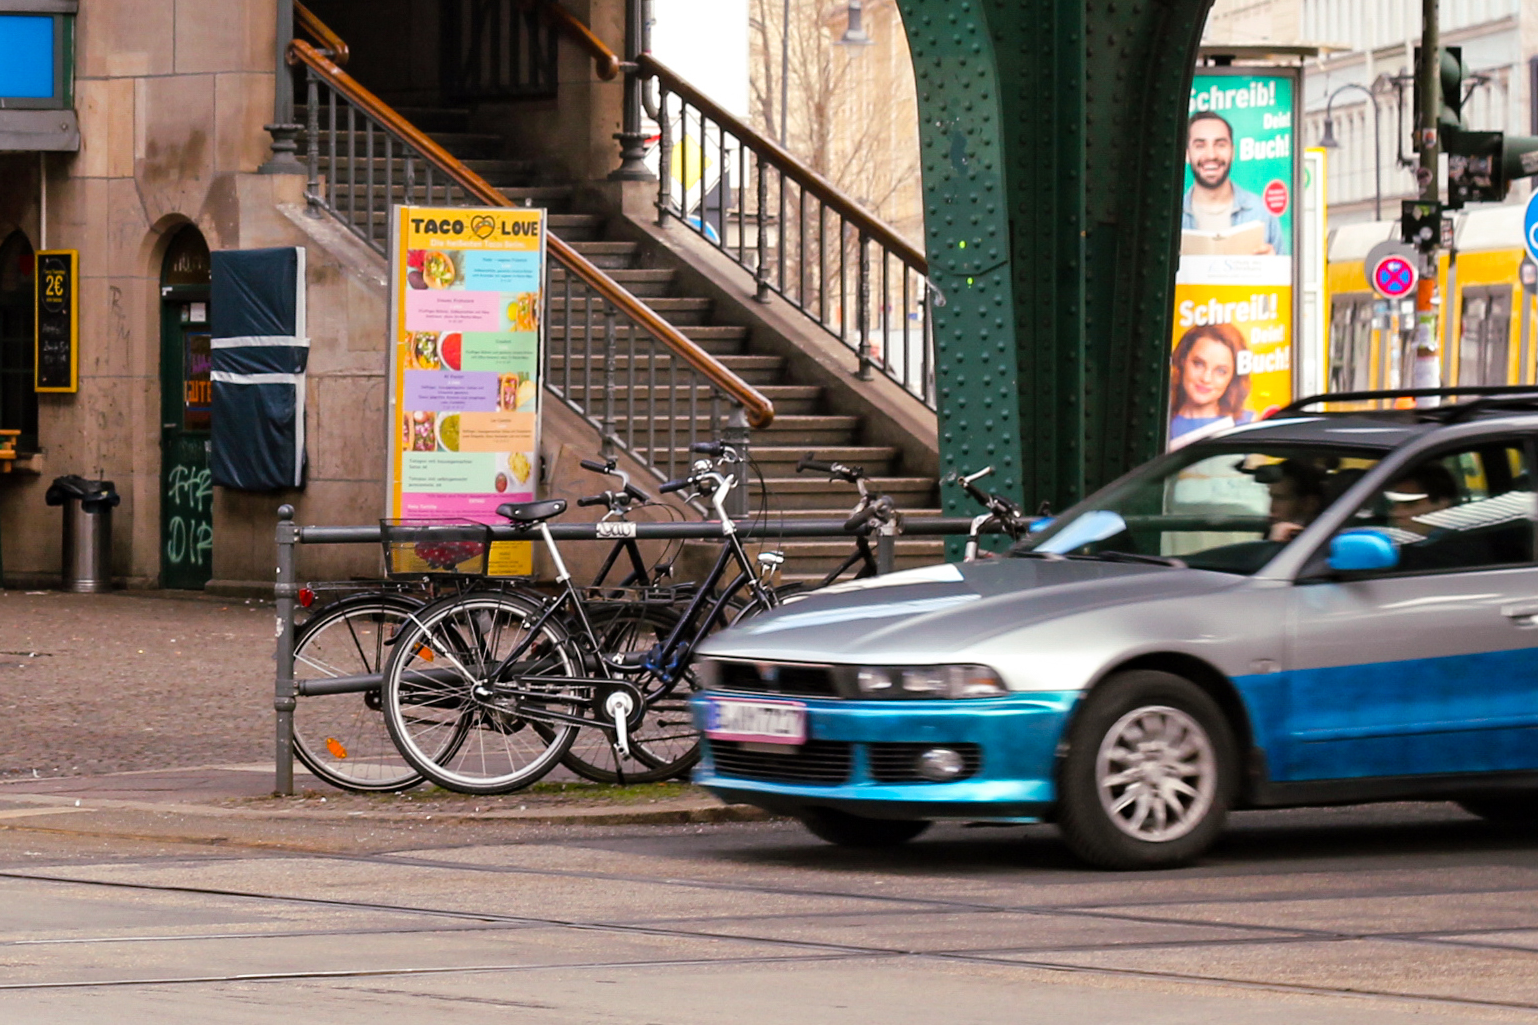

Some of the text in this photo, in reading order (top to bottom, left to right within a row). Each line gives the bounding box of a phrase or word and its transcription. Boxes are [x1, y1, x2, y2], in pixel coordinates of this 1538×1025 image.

[1263, 111, 1291, 130] Dein!
[1239, 133, 1290, 161] Buch!
[411, 218, 539, 237] TACO LOVE
[45, 275, 64, 296] 2€
[1178, 292, 1278, 328] Schreib!
[1250, 323, 1285, 345] Dein!
[1236, 345, 1290, 375] Buch!
